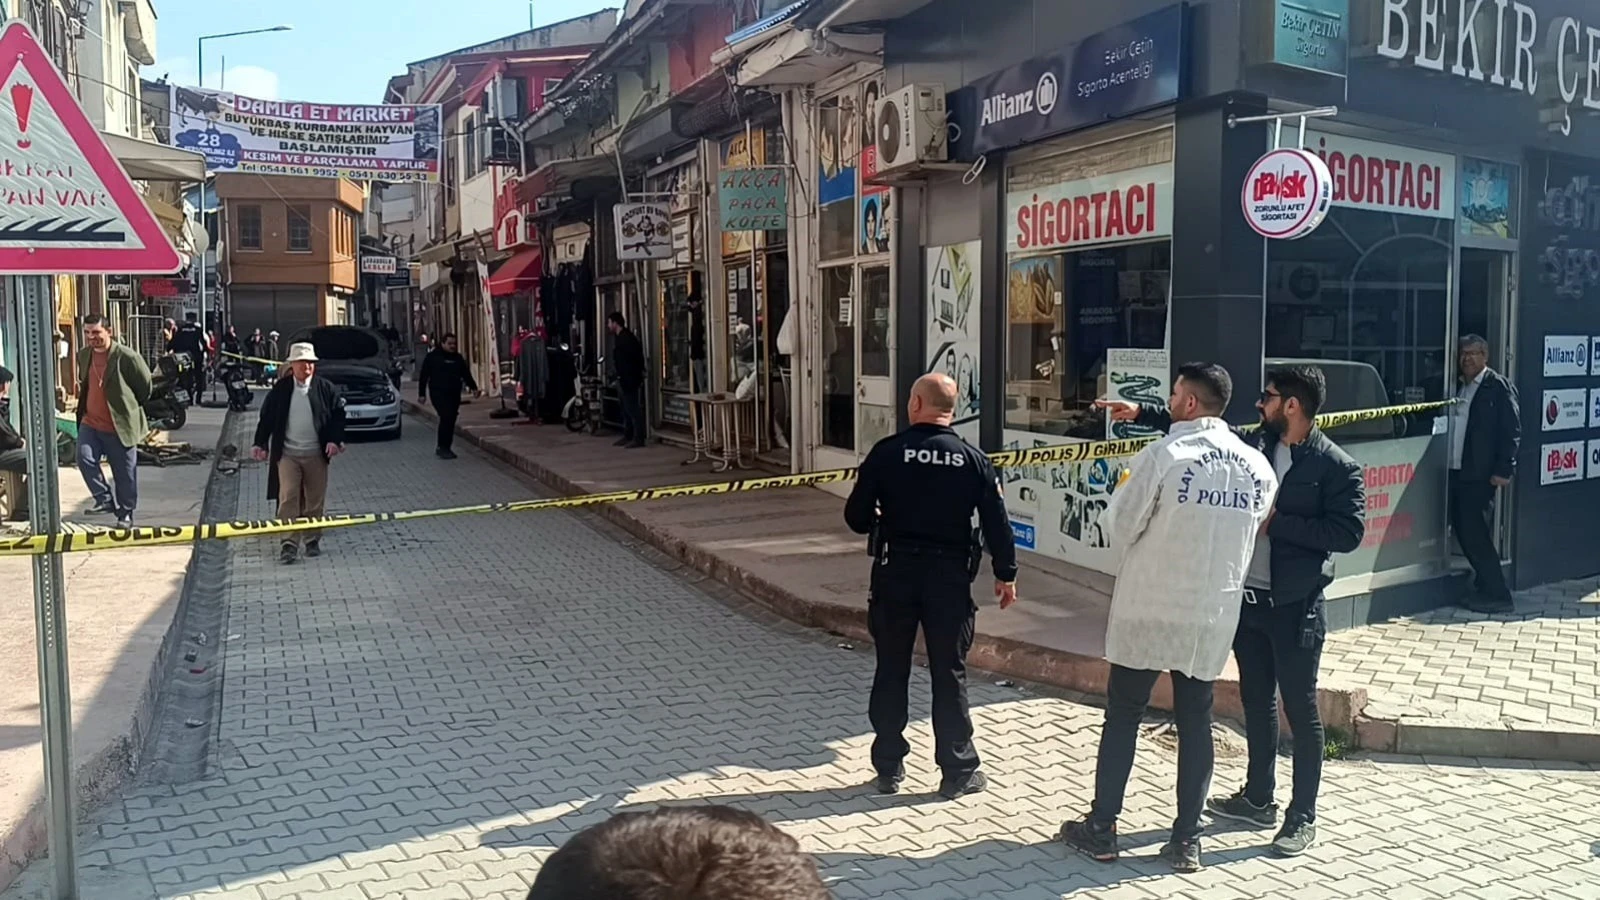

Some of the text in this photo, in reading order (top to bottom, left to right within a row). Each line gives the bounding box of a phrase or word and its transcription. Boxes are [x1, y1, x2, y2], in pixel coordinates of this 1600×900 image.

[1281, 11, 1307, 32] Bekir
[1104, 36, 1154, 65] Bekir Çetin
[1076, 59, 1153, 98] Sigorta Acenteliği
[238, 97, 411, 122] DAMLA ET MARKET
[980, 88, 1034, 127] Allianz
[249, 126, 265, 137] VE
[295, 121, 364, 134] KURBANLIK
[365, 125, 413, 135] HAYVAN
[198, 133, 220, 147] 28
[260, 164, 287, 173] 0544
[285, 154, 301, 164] VE
[303, 156, 378, 168] PARÇALAMA
[722, 172, 782, 192] AKÇA
[1303, 137, 1441, 212] GORTACI
[55, 189, 107, 207] VAR
[728, 198, 776, 213] PAÇA
[1253, 203, 1306, 213] ZORUNLU AFET
[1016, 182, 1156, 249] SİGORTACI
[1546, 347, 1575, 364] Allianz
[1177, 466, 1195, 504] OLAY
[1363, 463, 1415, 489] İGORTA
[1366, 489, 1390, 511] ETİN
